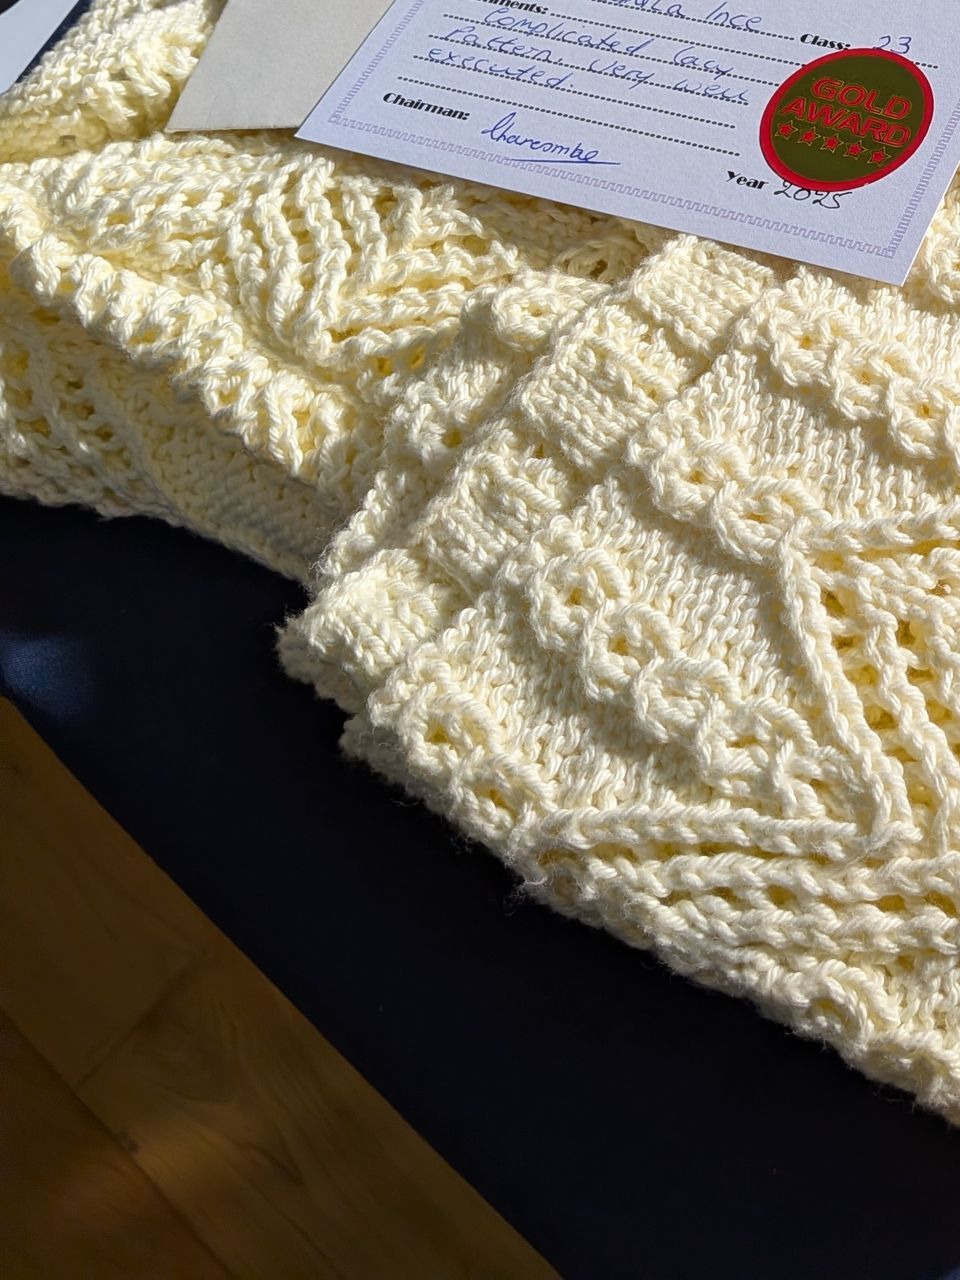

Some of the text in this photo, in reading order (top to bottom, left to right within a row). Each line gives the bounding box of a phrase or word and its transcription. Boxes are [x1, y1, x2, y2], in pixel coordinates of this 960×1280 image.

[704, 1, 764, 32] Ince
[799, 33, 852, 51] Class:
[871, 35, 913, 55] 23
[382, 91, 471, 121] Chairman:
[810, 77, 914, 121] GOLD
[779, 95, 912, 149] AWARD
[725, 169, 769, 191] Year
[772, 179, 853, 211] 2025
